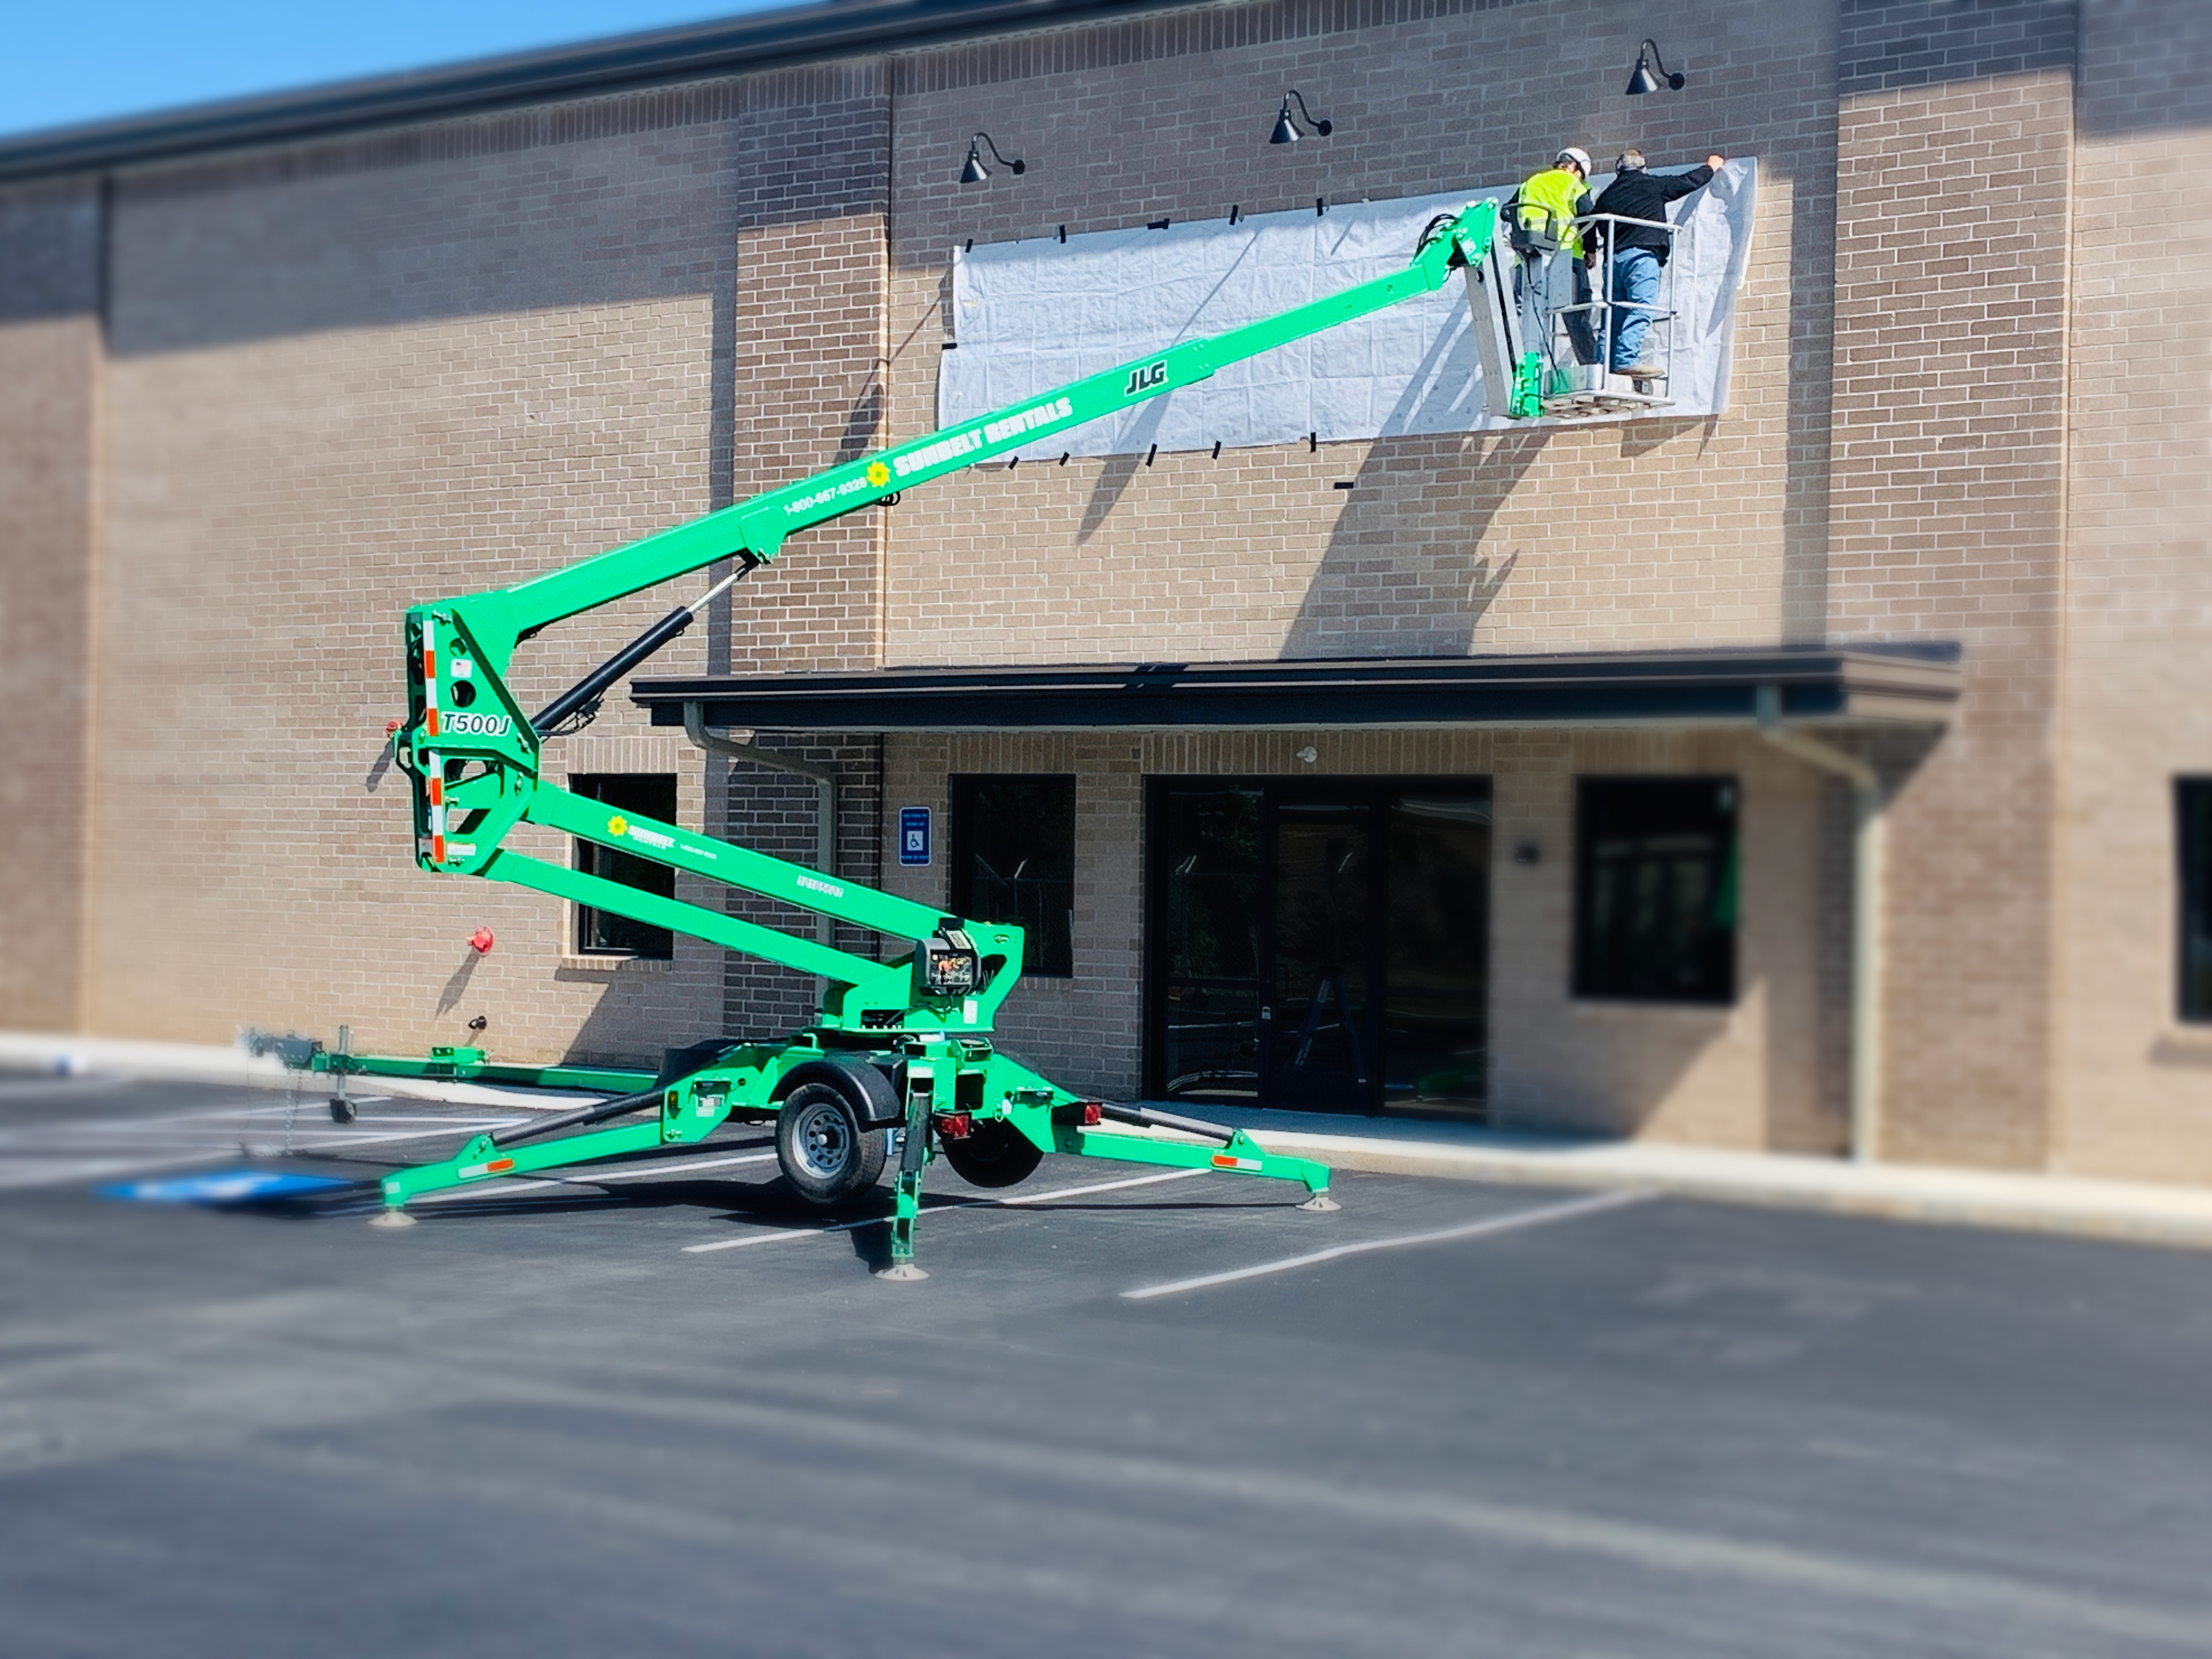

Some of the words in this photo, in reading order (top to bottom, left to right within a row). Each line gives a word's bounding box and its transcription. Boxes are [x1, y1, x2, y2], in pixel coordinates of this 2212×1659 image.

[1124, 360, 1166, 396] JLG
[893, 428, 983, 477] SUNBELT
[983, 397, 1073, 444] RENTALS
[441, 711, 512, 736] T500J
